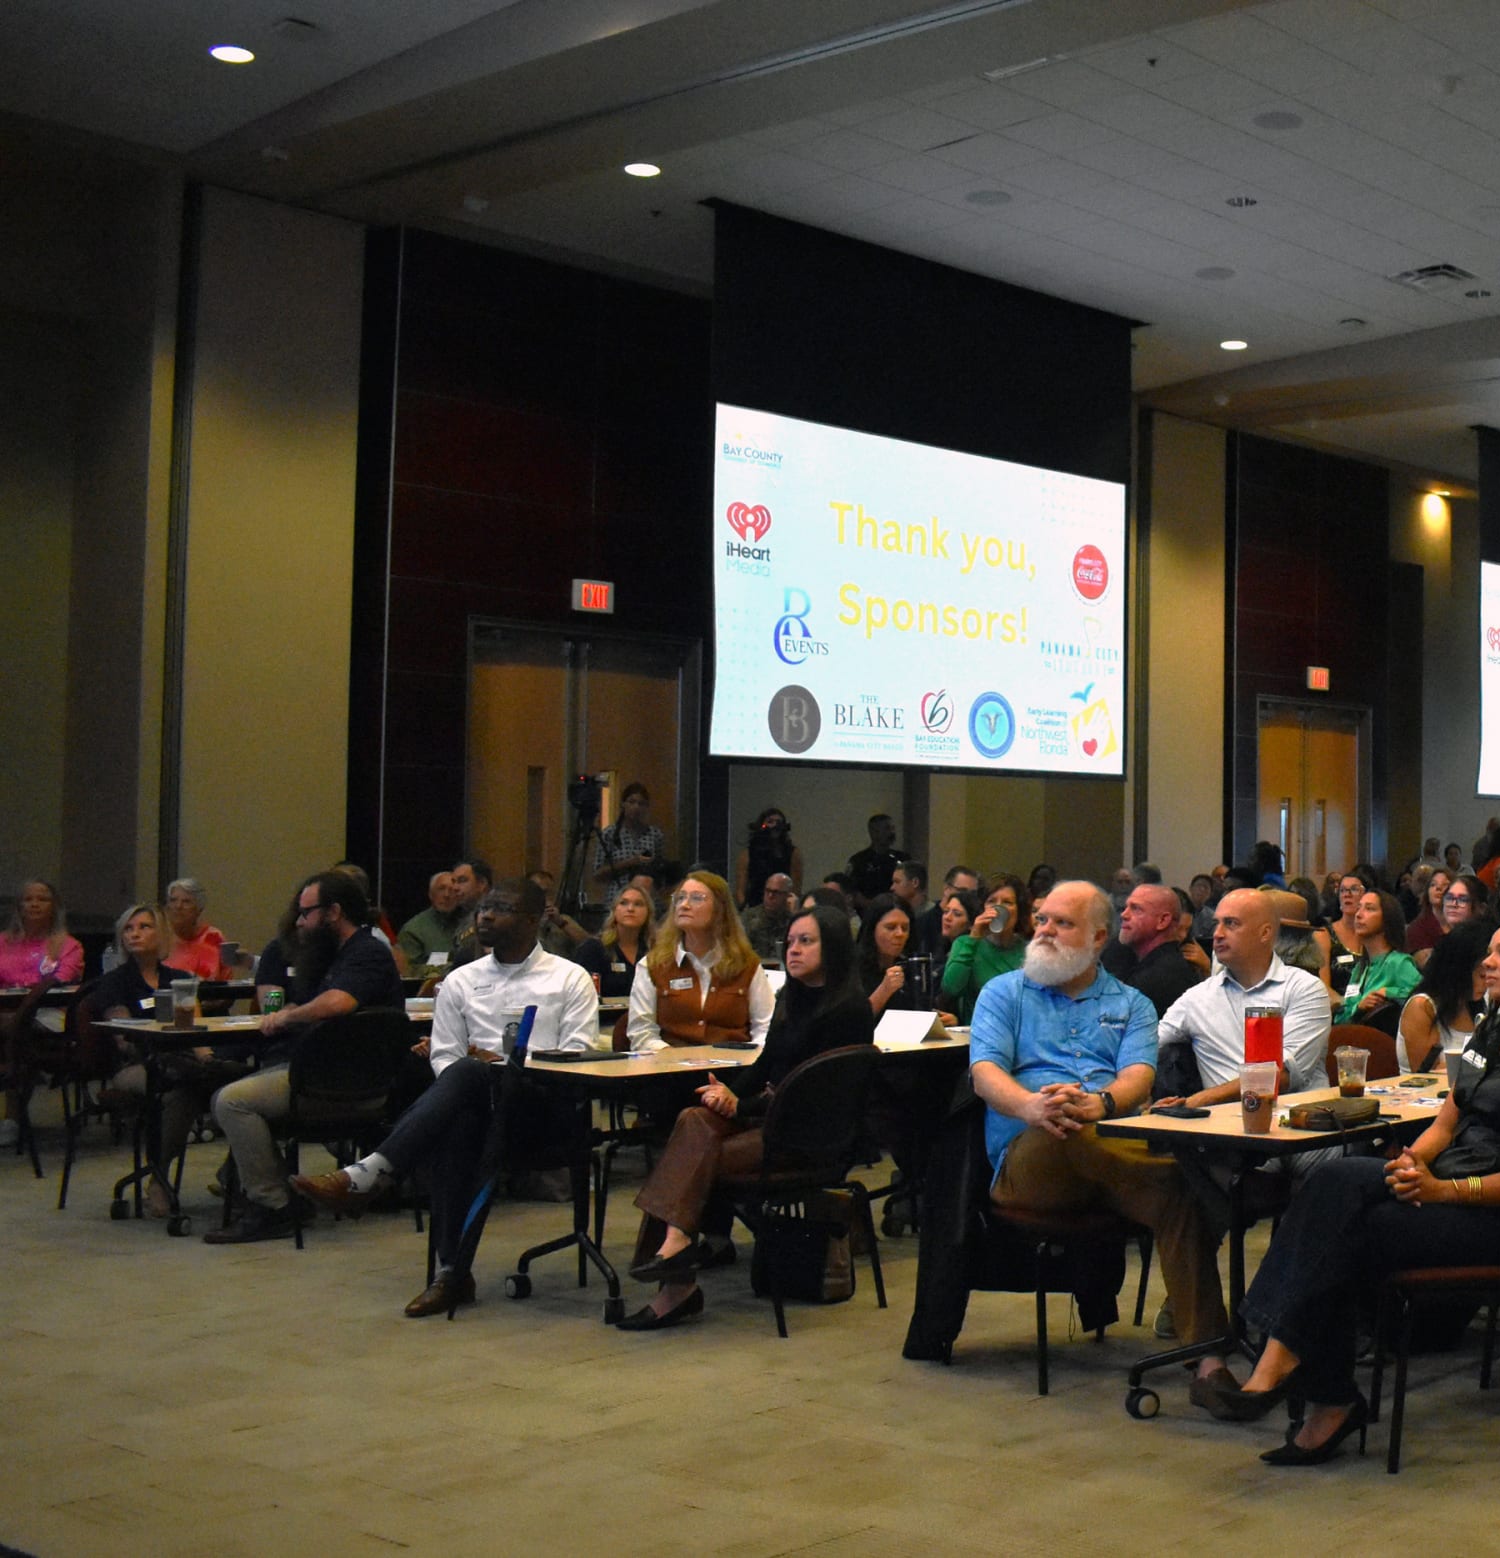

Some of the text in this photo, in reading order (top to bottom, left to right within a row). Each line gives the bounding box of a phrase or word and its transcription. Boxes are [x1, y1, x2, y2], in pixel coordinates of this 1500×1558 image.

[744, 447, 783, 463] COUNTY
[726, 541, 770, 562] iHeart
[829, 501, 1036, 582] Thank you,
[582, 583, 609, 609] EXIT
[838, 582, 1028, 645] Sponsors!
[784, 639, 829, 656] EVENTS
[860, 694, 879, 704] THE
[834, 704, 904, 729] BLAKE
